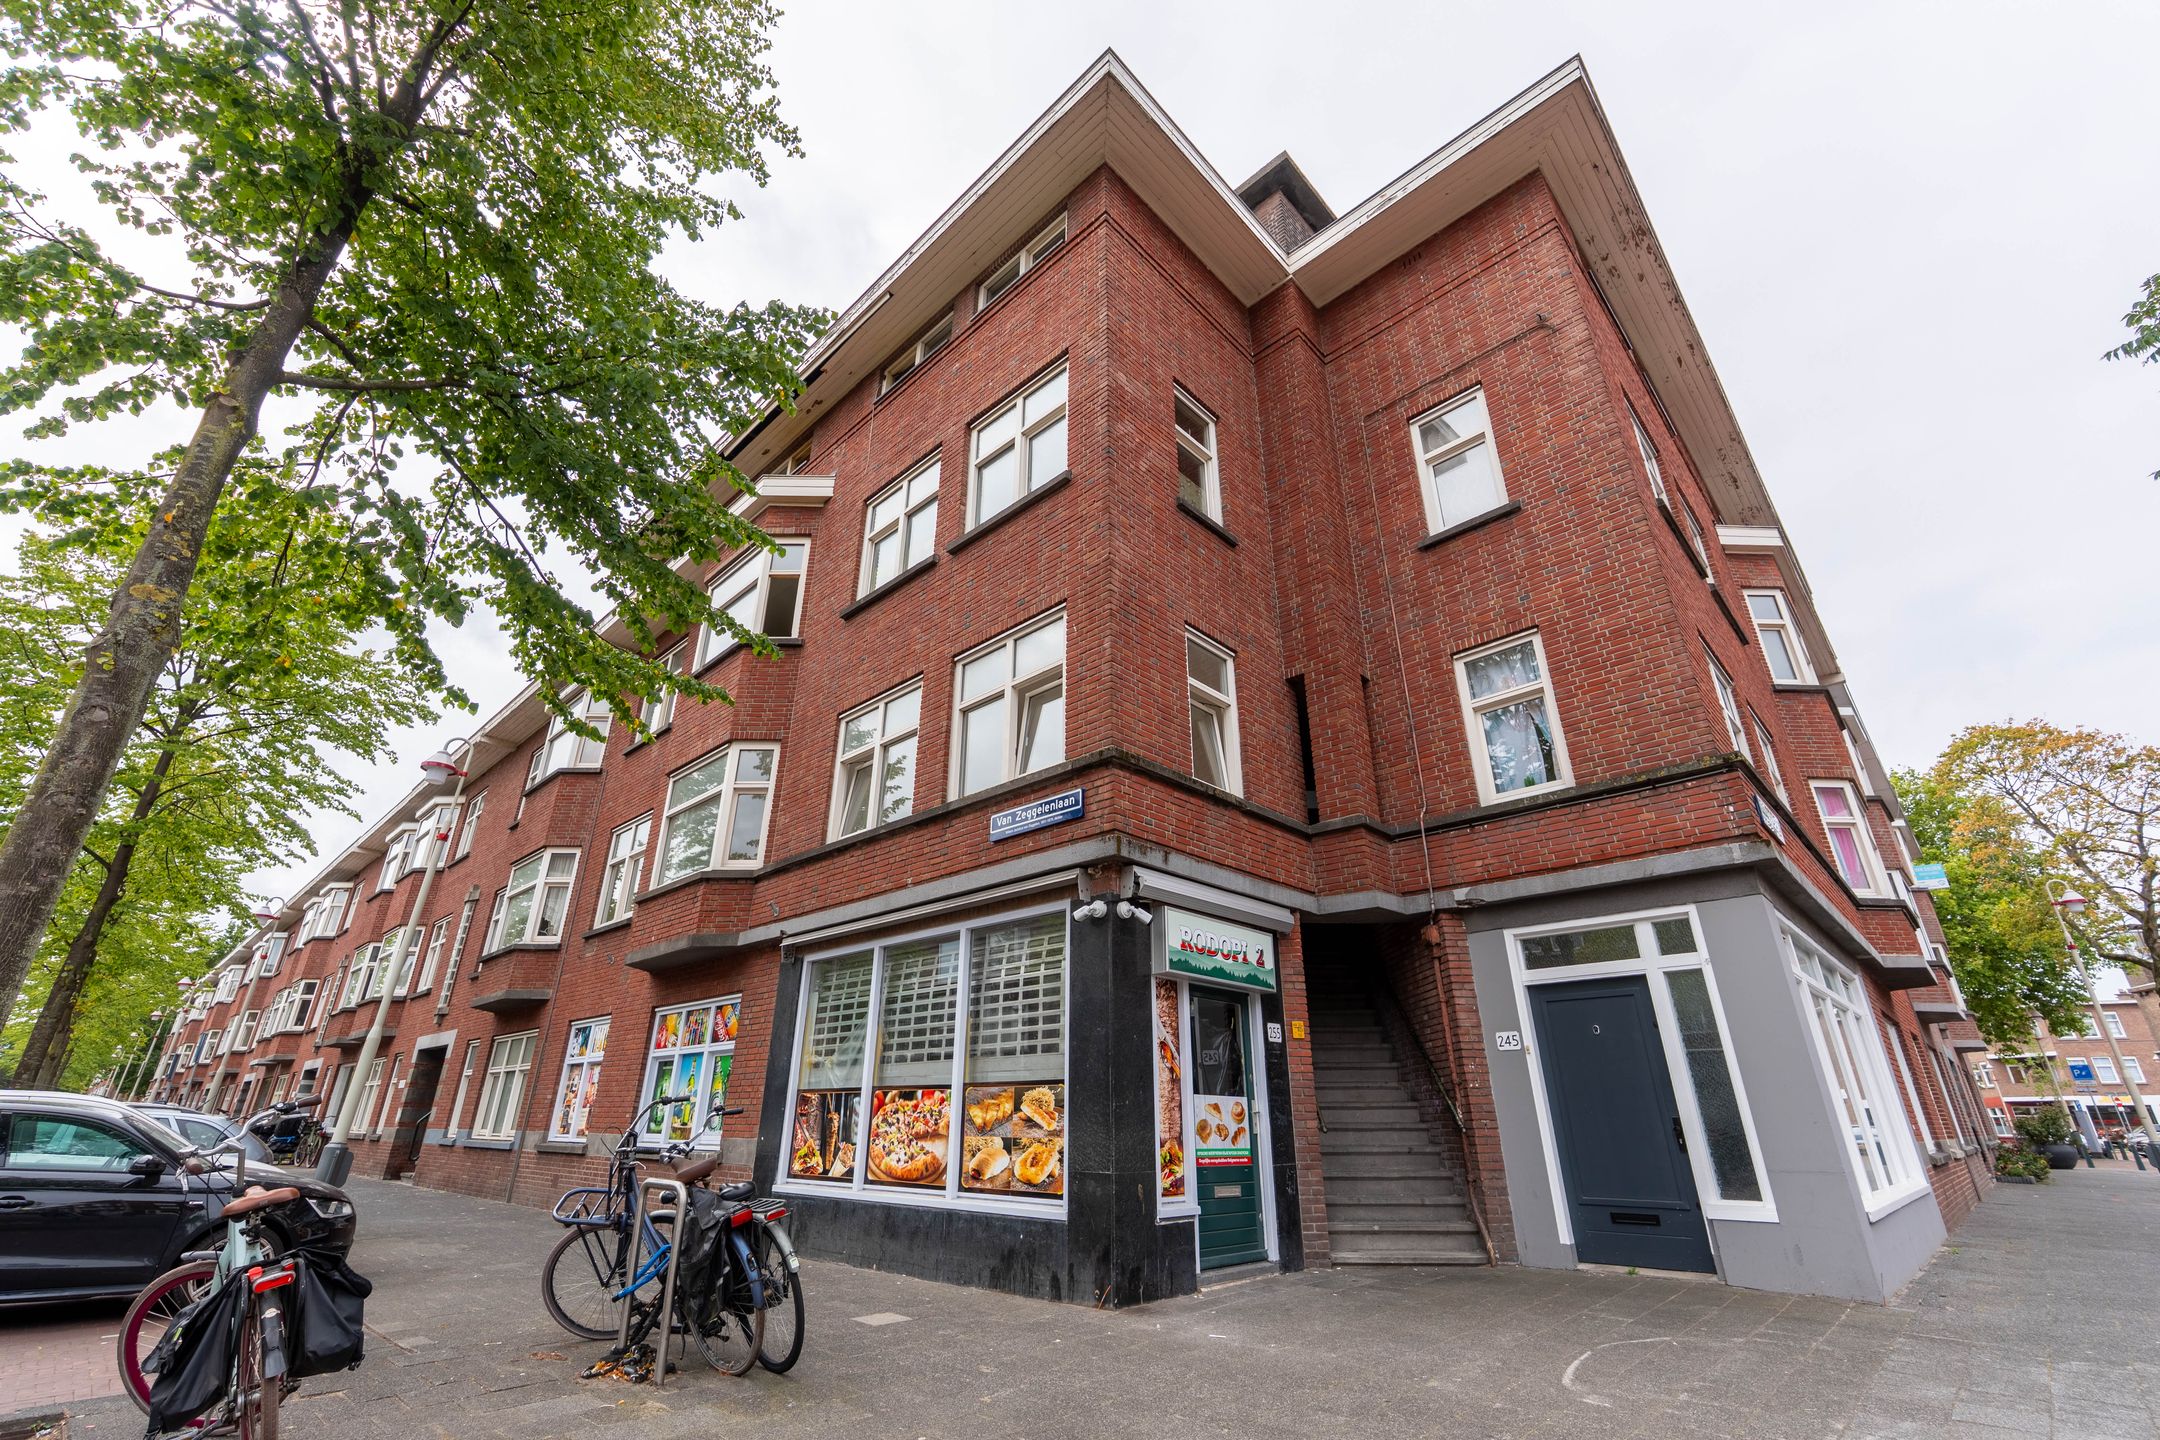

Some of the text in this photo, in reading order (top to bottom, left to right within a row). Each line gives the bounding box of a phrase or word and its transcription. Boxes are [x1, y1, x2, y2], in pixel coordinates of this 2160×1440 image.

[997, 816, 1012, 826] Van
[1016, 797, 1075, 820] Zeggelenlaan
[1180, 926, 1265, 968] RODOPI 2
[1269, 1026, 1280, 1039] 255
[1498, 1034, 1519, 1047] 245
[2074, 1069, 2080, 1077] P
